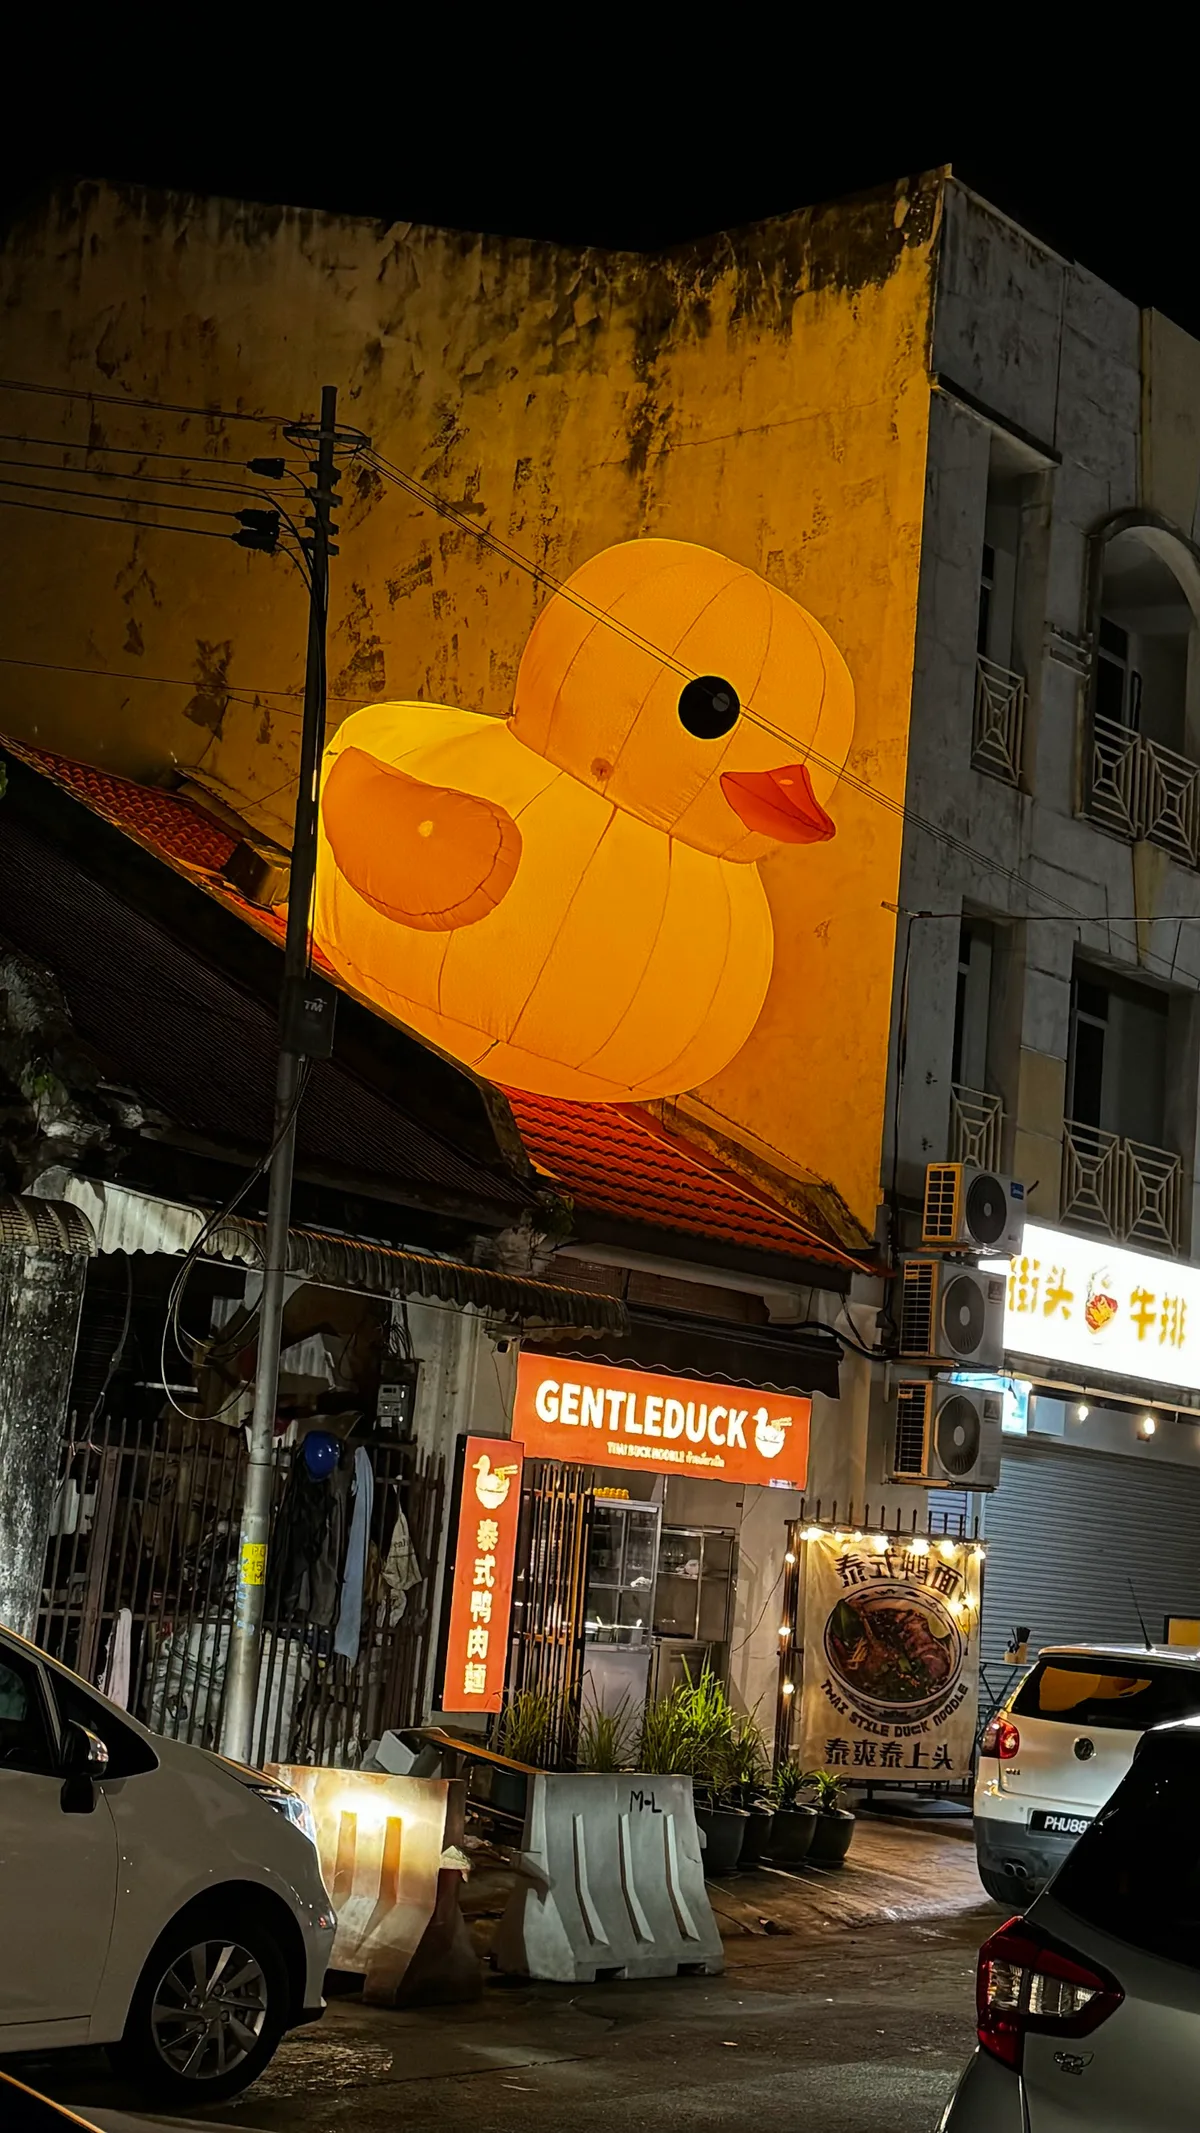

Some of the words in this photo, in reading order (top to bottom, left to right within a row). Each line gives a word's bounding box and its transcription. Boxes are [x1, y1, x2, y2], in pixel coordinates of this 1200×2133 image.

[304, 999, 326, 1013] TM
[535, 1379, 748, 1449] GENTLEDUCK
[835, 1548, 963, 1596] 泰式鸭面
[820, 1679, 849, 1716] THAI
[849, 1711, 890, 1738] STYLE
[894, 1720, 931, 1738] DUCK
[932, 1683, 969, 1727] NOODLE
[824, 1737, 954, 1771] 泰爽泰上头
[1044, 1815, 1091, 1835] PHU88
